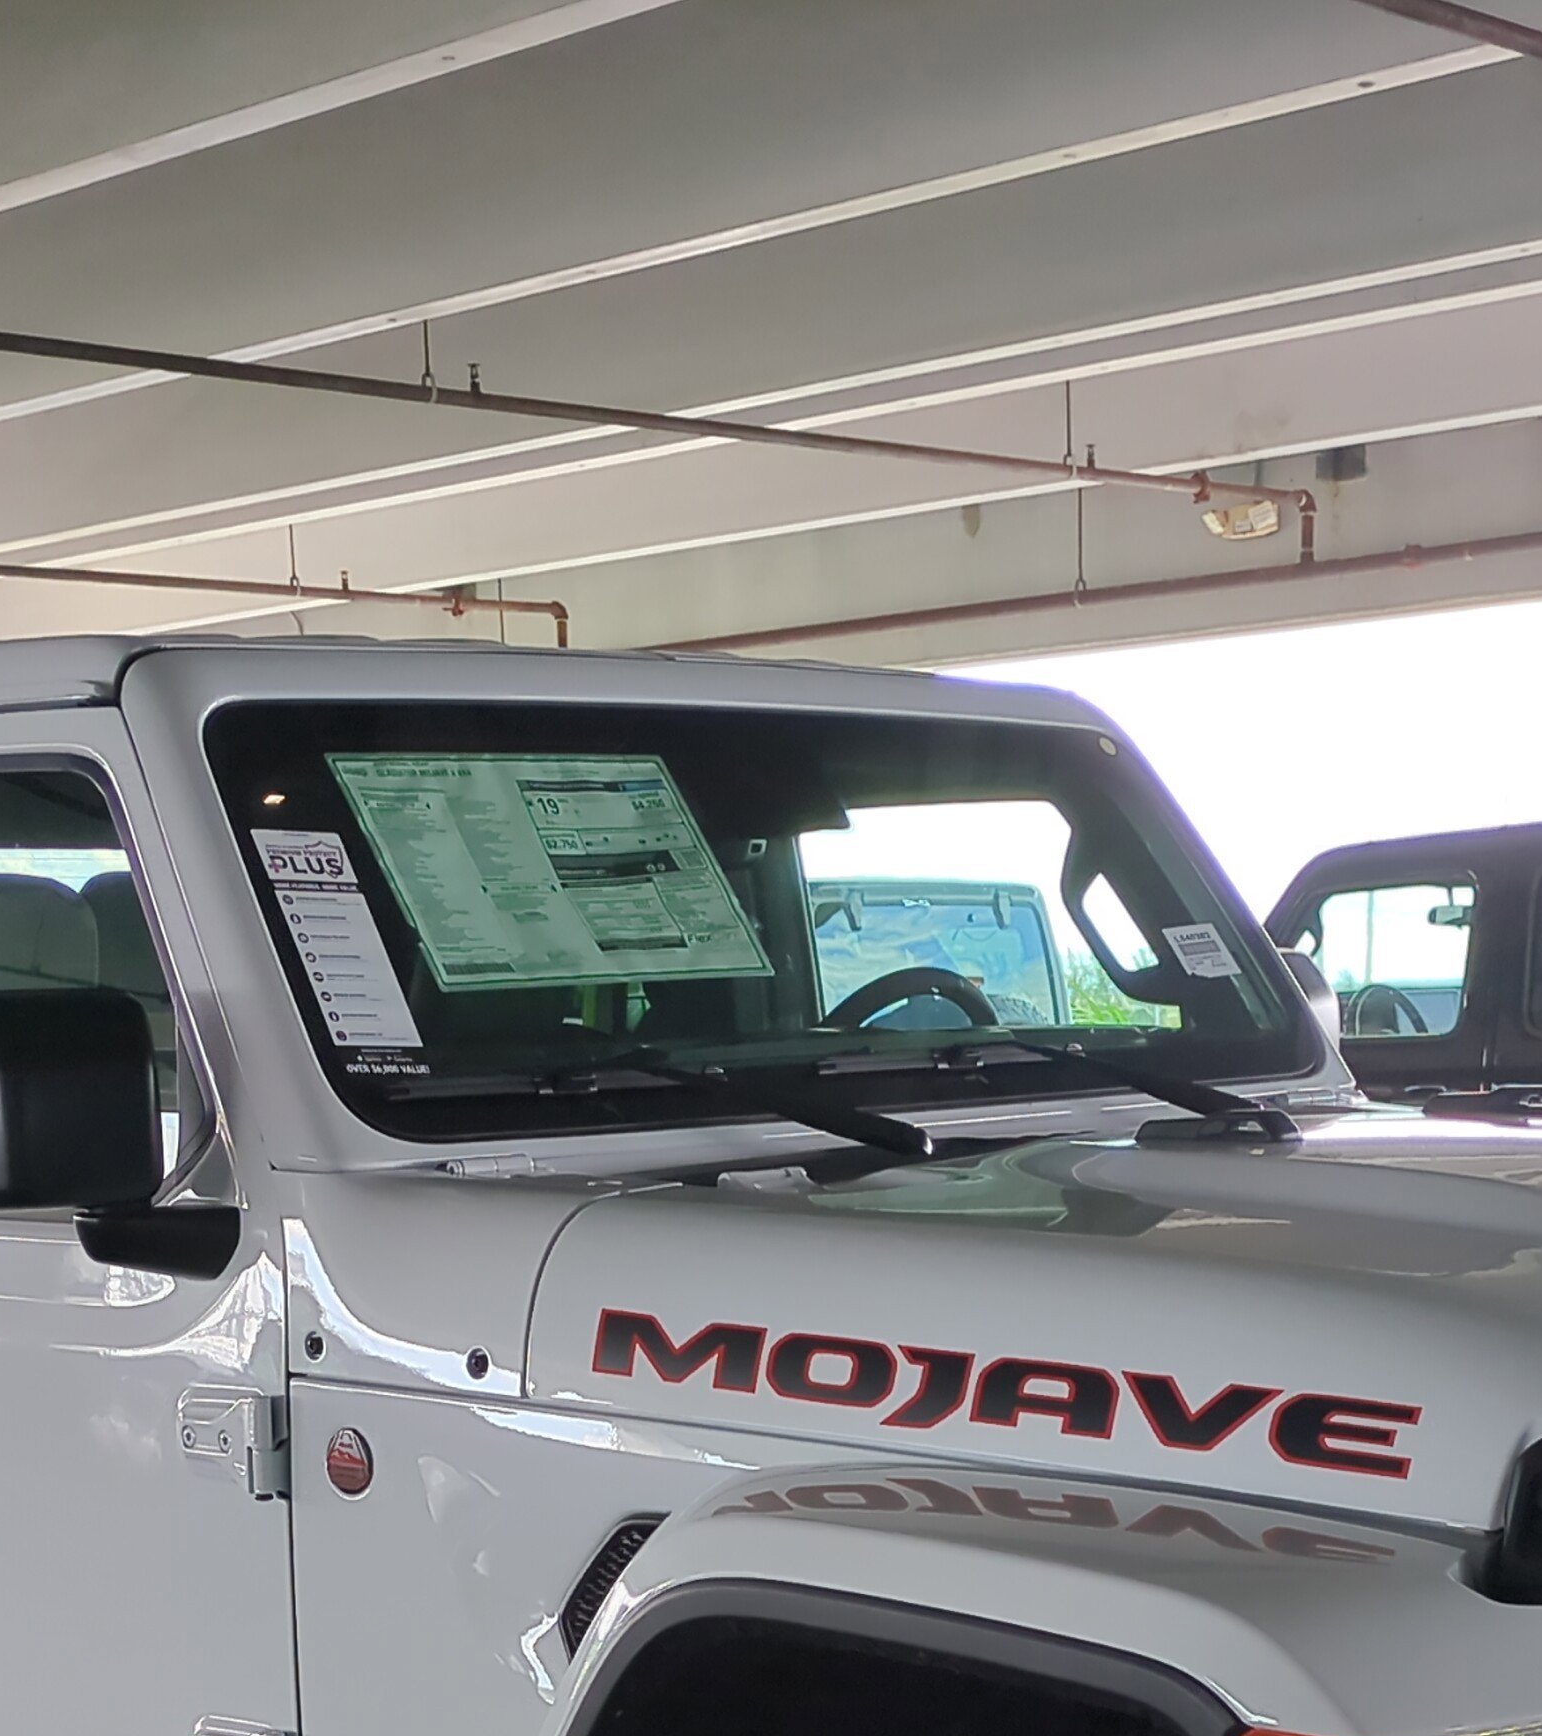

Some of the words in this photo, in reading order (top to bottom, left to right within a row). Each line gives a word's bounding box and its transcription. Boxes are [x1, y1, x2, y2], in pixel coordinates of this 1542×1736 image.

[536, 797, 560, 815] 19
[268, 855, 344, 876] PLUS
[591, 1307, 1424, 1481] MOJAVE
